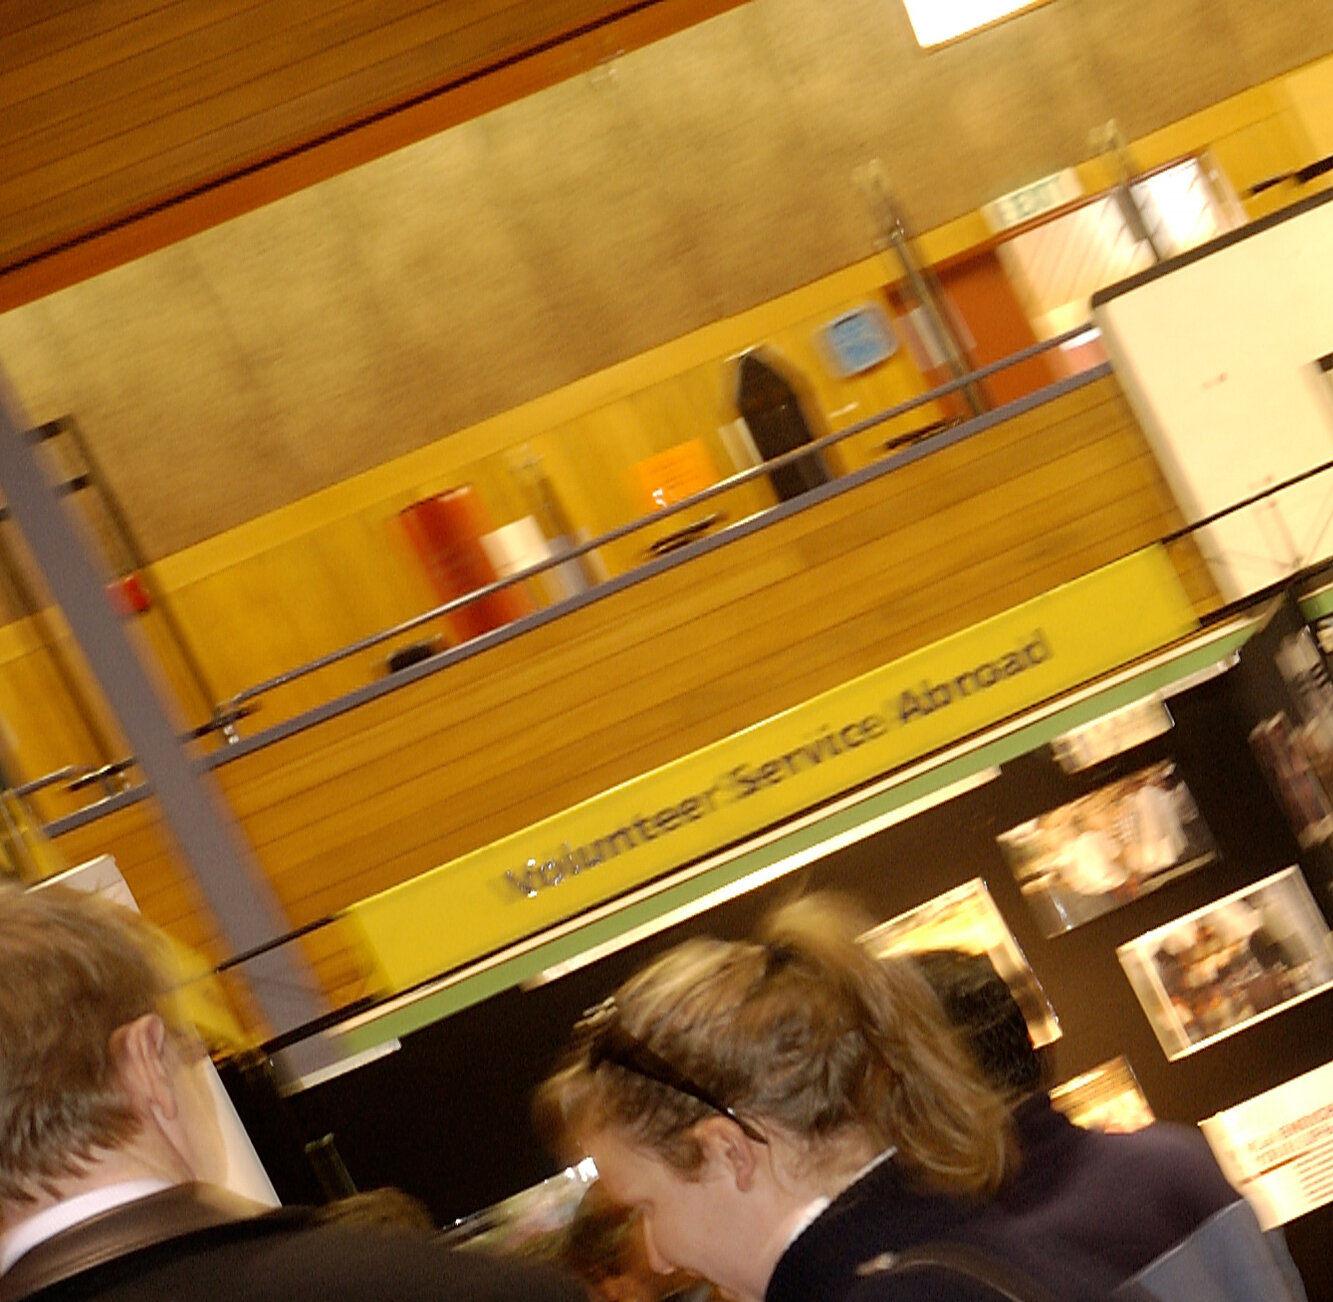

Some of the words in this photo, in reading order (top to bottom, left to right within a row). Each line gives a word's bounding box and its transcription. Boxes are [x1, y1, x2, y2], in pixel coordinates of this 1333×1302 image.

[502, 788, 722, 897] Volunteer
[728, 716, 886, 802] Service
[893, 629, 1053, 724] Abroad
